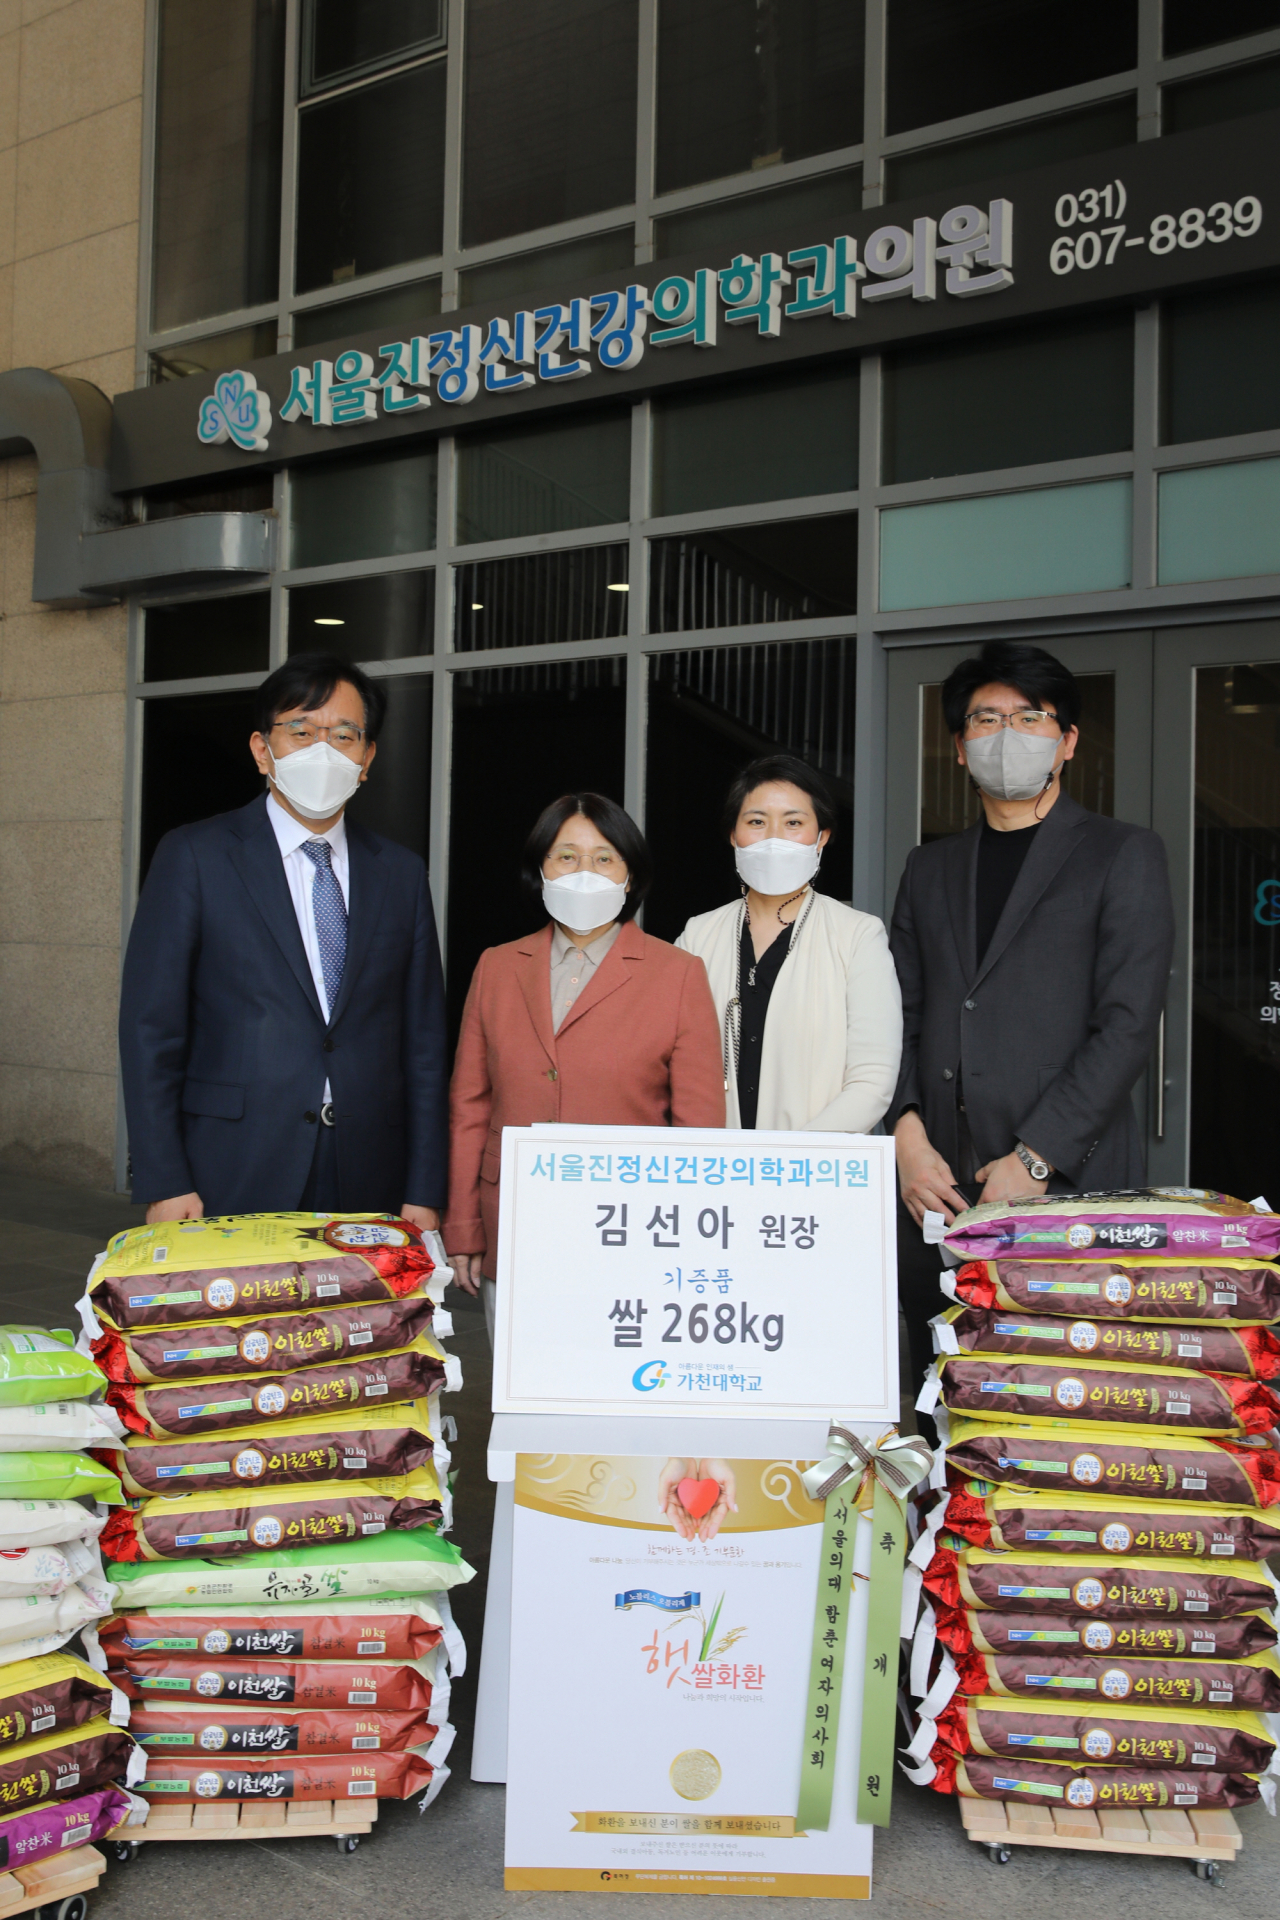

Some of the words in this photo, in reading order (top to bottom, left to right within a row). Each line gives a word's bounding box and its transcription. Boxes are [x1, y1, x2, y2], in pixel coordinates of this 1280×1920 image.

[1055, 179, 1127, 228] 031)
[1049, 196, 1263, 276] 607-8839
[279, 198, 1014, 427] 서울진정신건강의학과의원
[529, 1152, 870, 1188] 서울진정신건강의학과의원
[758, 1214, 820, 1250] 원장
[1100, 1225, 1157, 1248] 이천쌀
[1173, 1230, 1210, 1242] 알찬米
[240, 1277, 298, 1298] 이천쌀
[662, 1266, 734, 1295] 기증품
[1137, 1282, 1195, 1299] 이천쌀
[608, 1298, 648, 1348] 쌀
[661, 1301, 785, 1352] 268kg
[274, 1327, 330, 1351] 이천쌀
[1103, 1330, 1160, 1348] 이천쌀
[678, 1363, 704, 1371] 아름다운
[291, 1379, 348, 1402] 이천쌀
[677, 1373, 763, 1393] 가천대학교
[1090, 1387, 1147, 1406] 이천쌀
[268, 1450, 325, 1470] 이천쌀
[1106, 1463, 1164, 1481] 이천쌀
[287, 1515, 344, 1536] 이천쌀
[647, 1543, 683, 1556] 함께하는
[714, 1545, 746, 1558] 기부문화
[1135, 1532, 1193, 1551] 이천쌀
[628, 1592, 656, 1602] 노블리스
[1108, 1586, 1166, 1606] 이천쌀
[236, 1631, 294, 1652] 이천쌀
[1117, 1629, 1173, 1647] 이천쌀
[228, 1677, 287, 1700] 이천쌀
[1135, 1678, 1192, 1697] 이천쌀
[232, 1727, 290, 1749] 이천쌀
[1117, 1739, 1173, 1757] 이천쌀
[227, 1774, 285, 1796] 이천쌀
[1100, 1783, 1156, 1801] 이천쌀
[598, 1818, 626, 1828] 화환을
[629, 1818, 657, 1828] 보내신
[660, 1819, 678, 1829] 분이
[682, 1820, 700, 1830] 쌀을
[704, 1820, 723, 1830] 함께
[725, 1820, 781, 1831] 보내셨습니다
[16, 1832, 52, 1854] 알찬米
